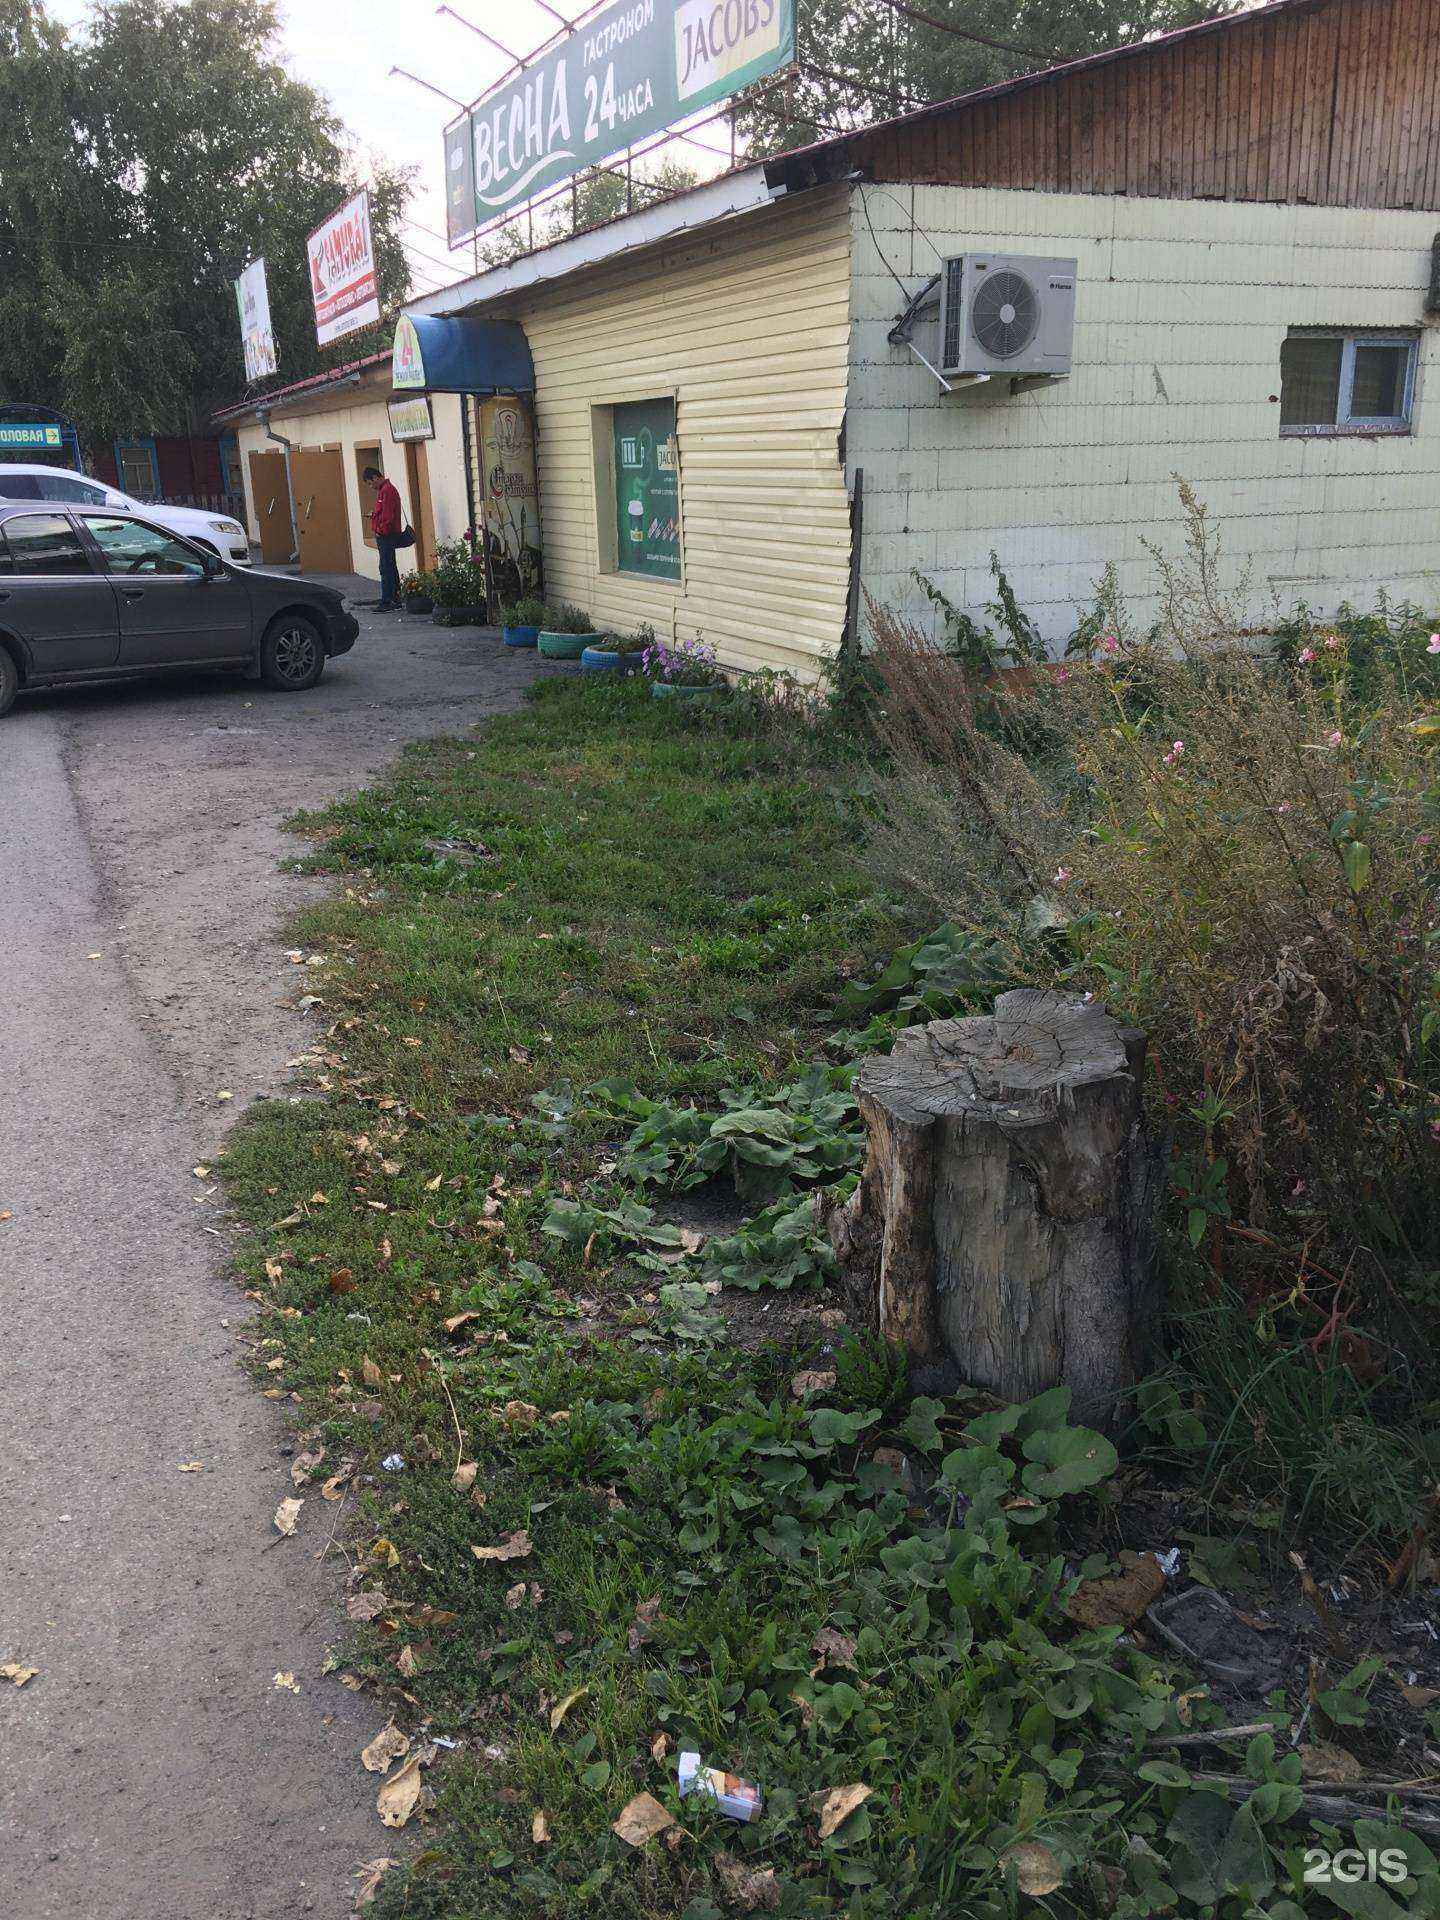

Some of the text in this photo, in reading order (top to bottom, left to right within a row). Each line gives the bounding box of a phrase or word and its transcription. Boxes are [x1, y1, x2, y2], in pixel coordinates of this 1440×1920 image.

[584, 0, 654, 67] ГАСТРОНОМ
[474, 59, 571, 193] ВЕСНА
[584, 62, 654, 143] 24 ЧАСА
